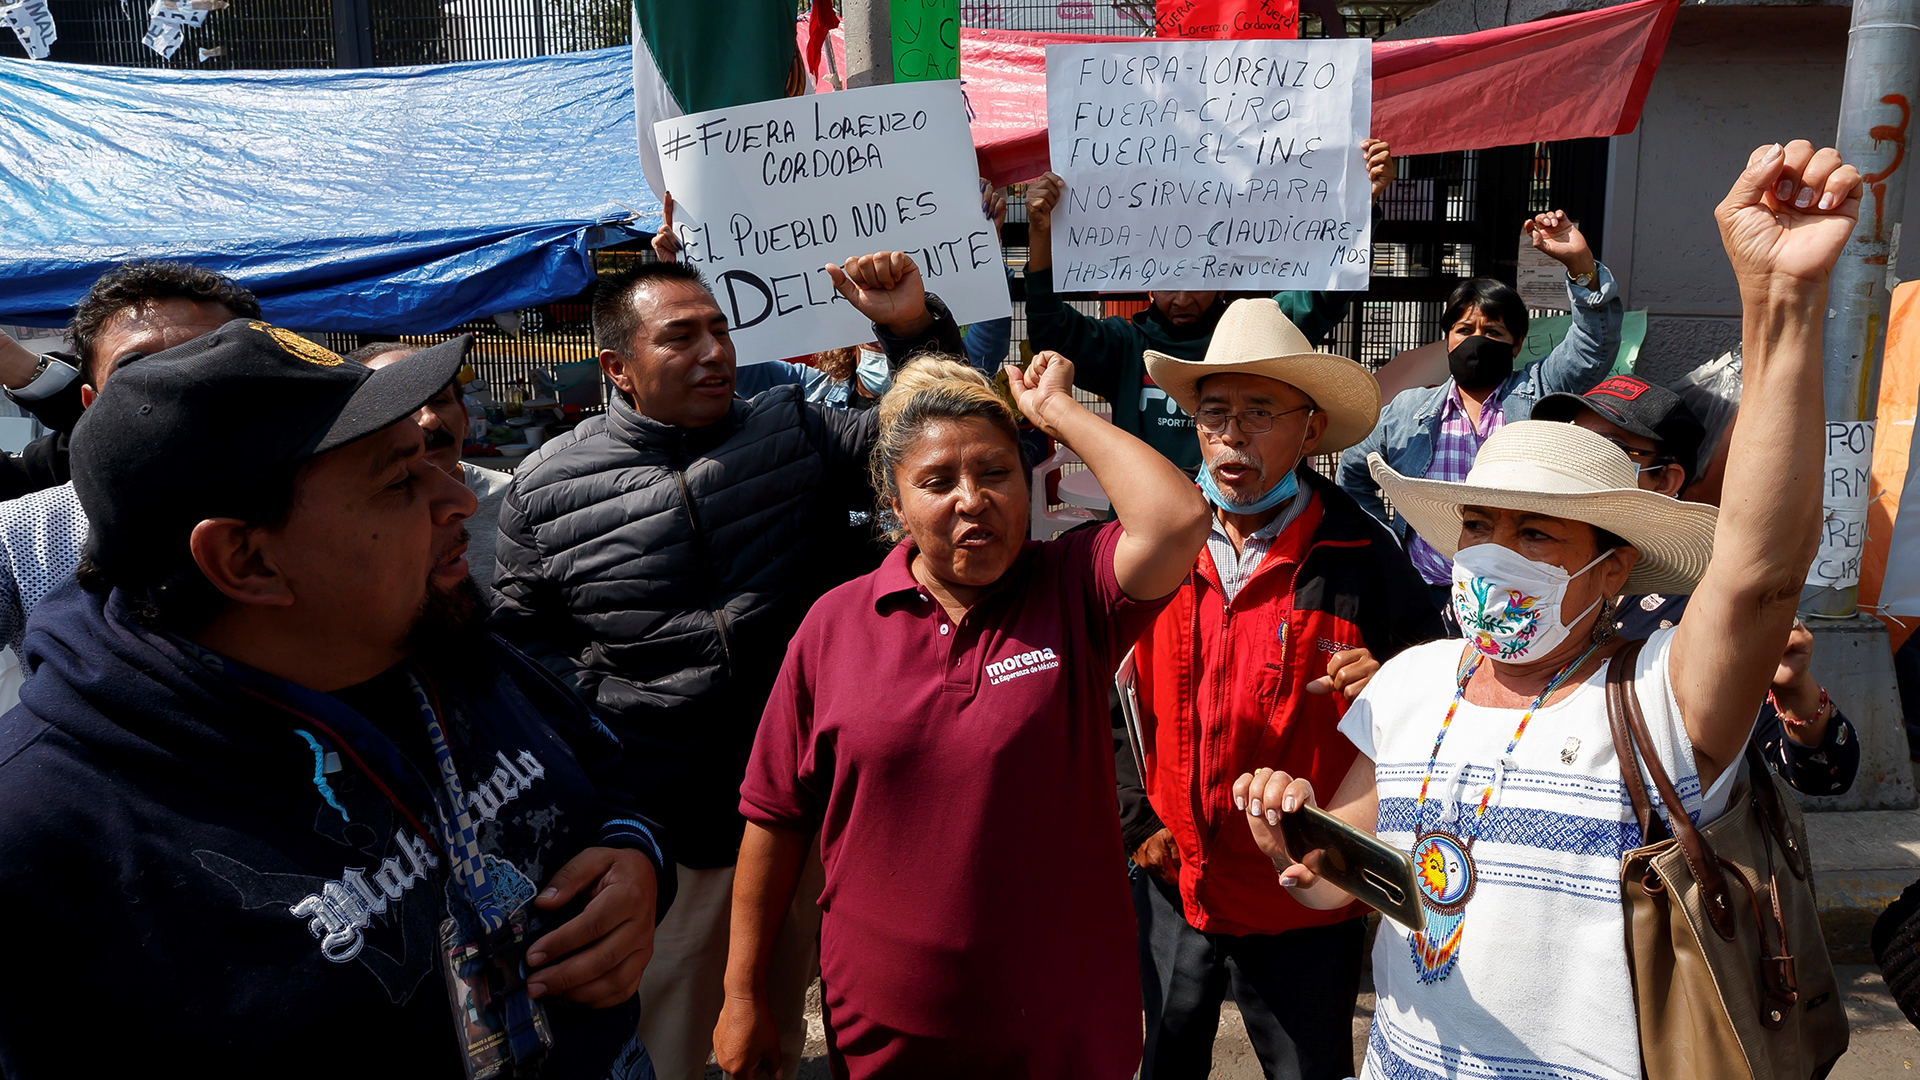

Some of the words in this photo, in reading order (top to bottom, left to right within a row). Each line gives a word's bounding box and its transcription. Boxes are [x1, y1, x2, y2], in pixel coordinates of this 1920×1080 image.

[1156, 0, 1195, 34] FUERA
[1178, 23, 1229, 37] Lorenzo
[1234, 11, 1281, 31] Cordova
[662, 118, 795, 161] #FUERA
[814, 102, 928, 142] LORENZO
[762, 143, 883, 186] CORDOBA
[730, 213, 837, 257] PUEBLO
[852, 202, 886, 238] NO
[896, 191, 938, 225] ES
[1330, 245, 1368, 267] MOS
[1157, 417, 1186, 428] SPORT
[985, 648, 1056, 678] morena
[999, 668, 1030, 682] Esperanza
[1038, 661, 1059, 672] México
